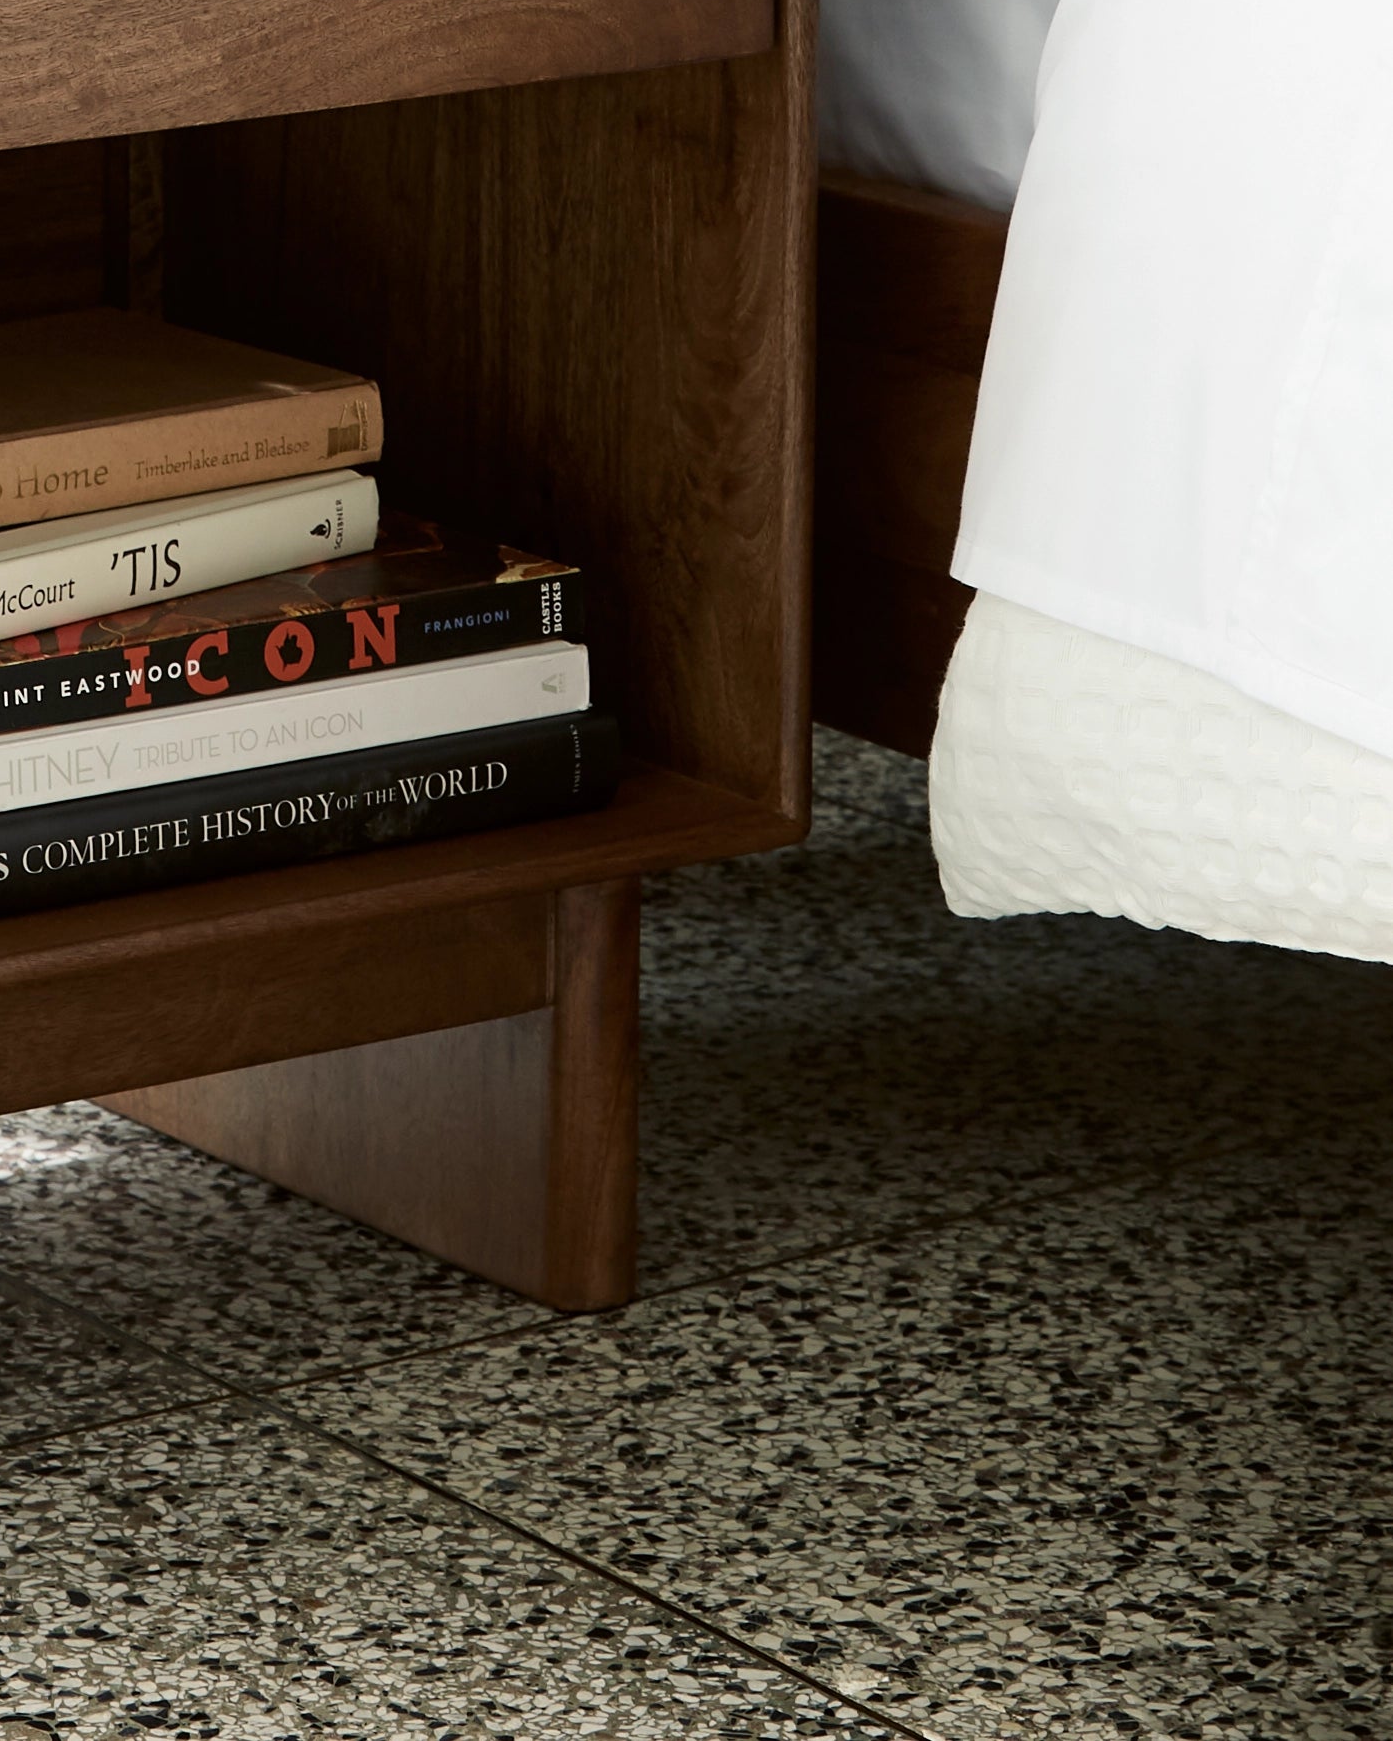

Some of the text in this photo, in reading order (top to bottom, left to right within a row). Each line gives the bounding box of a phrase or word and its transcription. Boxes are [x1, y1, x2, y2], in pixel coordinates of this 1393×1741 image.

[15, 462, 110, 500] Home
[134, 449, 219, 480] Timberlake
[221, 441, 250, 464] and
[255, 435, 311, 460] Bledsoe
[424, 610, 510, 635] FRANGIONI
[540, 582, 551, 635] CASTLE
[552, 581, 563, 633] BOOKS
[60, 659, 202, 699] EASTWOOD
[124, 603, 401, 709] ICON
[133, 734, 222, 773] TRIBUTE
[227, 729, 259, 754] TO
[265, 718, 298, 748] AN
[305, 709, 364, 740] ICON
[22, 817, 191, 875] COMPLETE
[200, 790, 336, 843] HISTORY
[336, 793, 359, 812] OF
[363, 786, 398, 807] THE
[397, 760, 508, 806] WORLD
